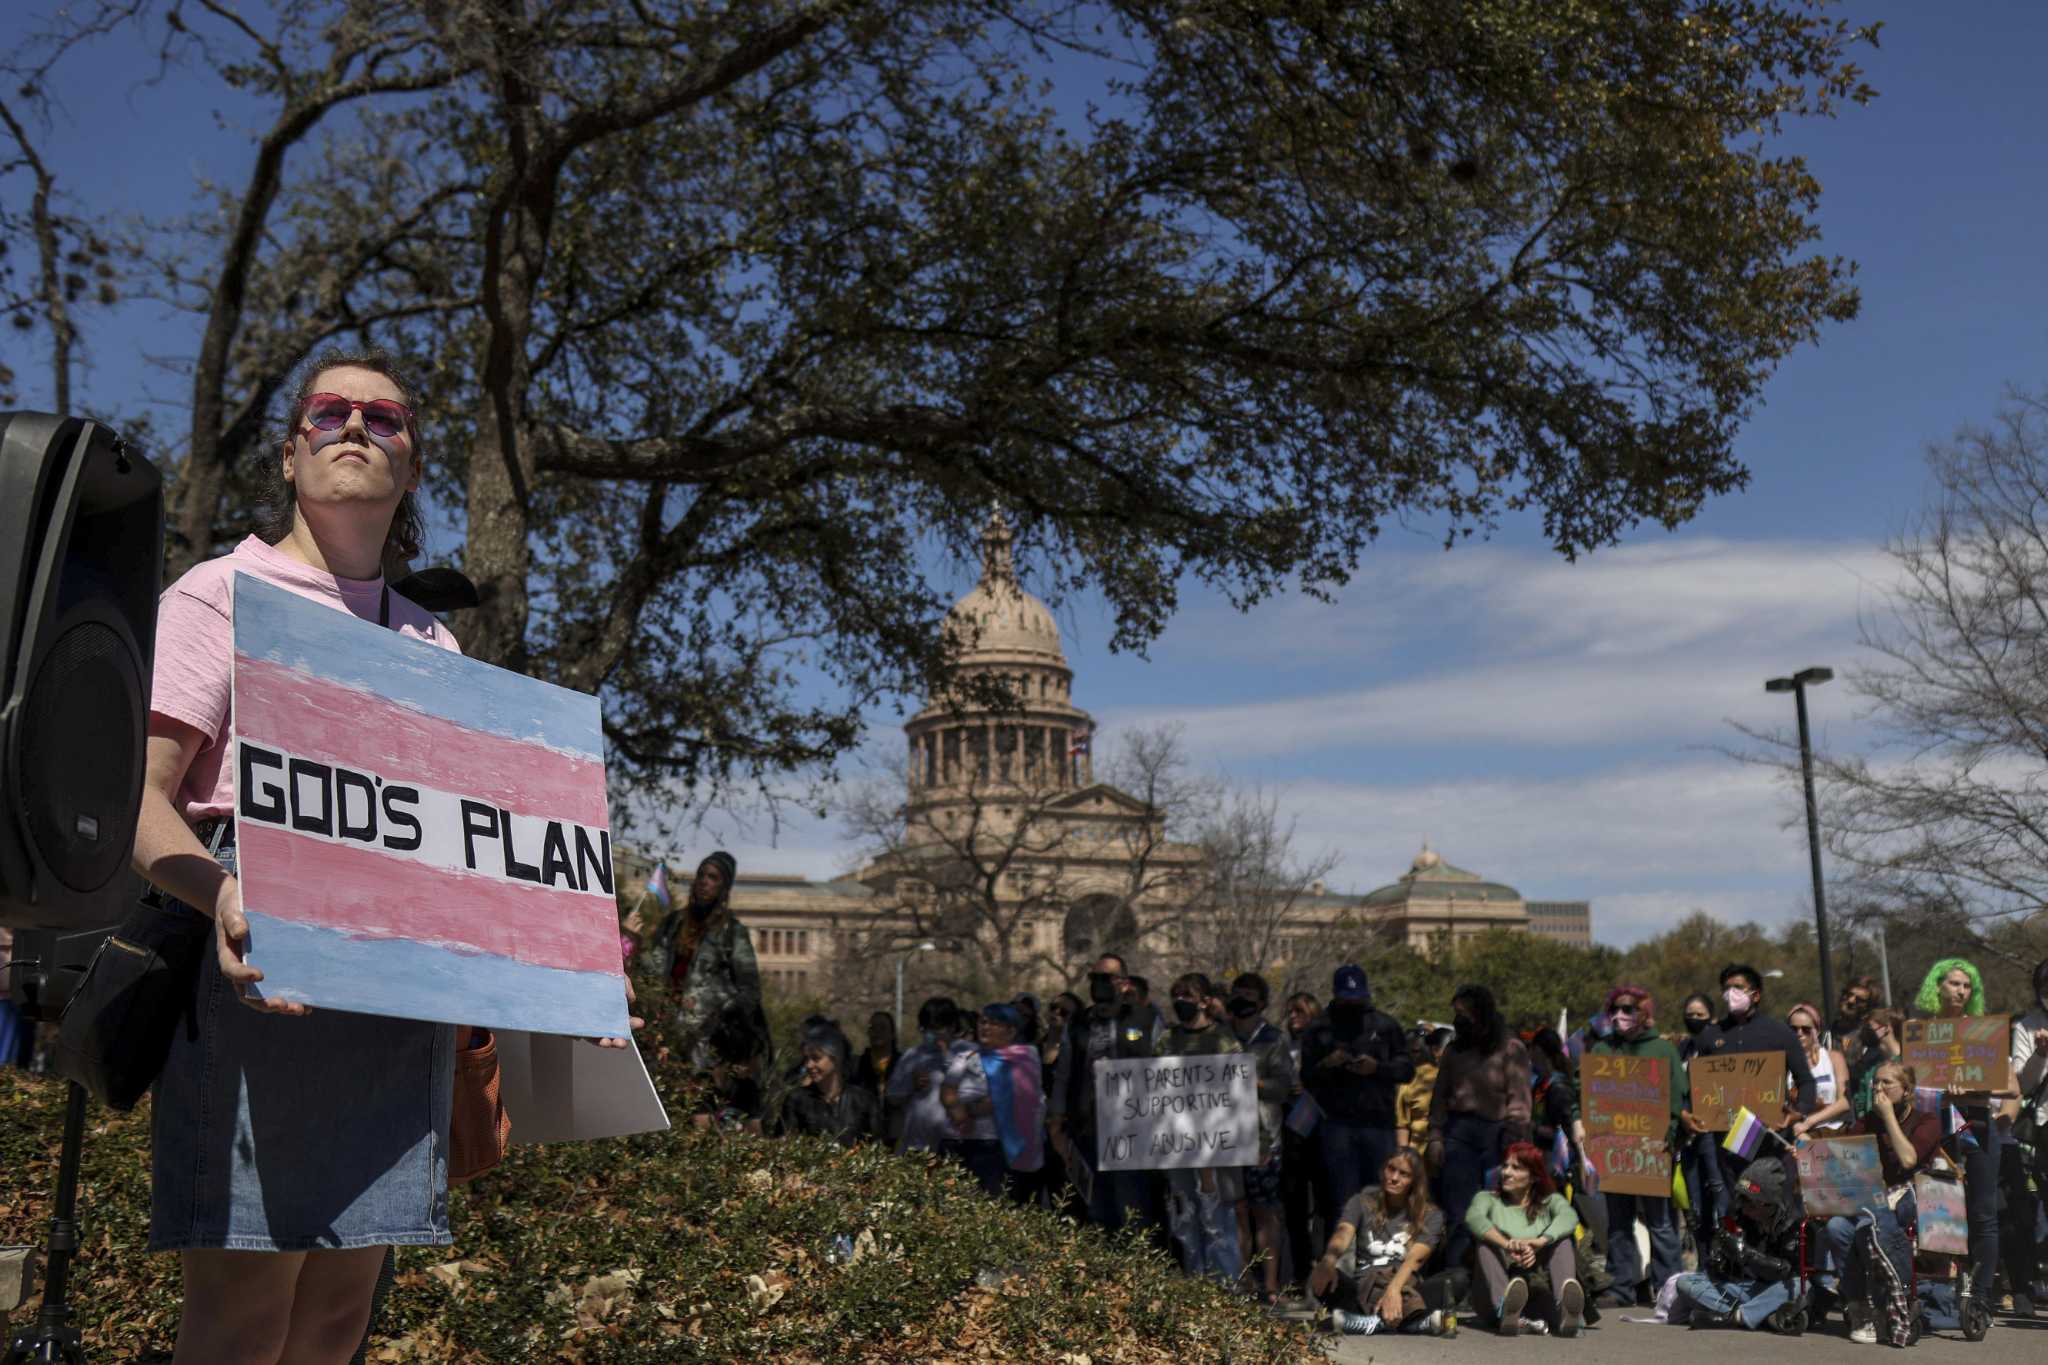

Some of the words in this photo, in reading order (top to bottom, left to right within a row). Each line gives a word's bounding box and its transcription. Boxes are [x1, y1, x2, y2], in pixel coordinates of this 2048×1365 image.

[240, 742, 422, 851] GOD'S
[460, 799, 614, 894] PLAN
[1105, 1070, 1132, 1096] MY
[1144, 1065, 1215, 1090] PARENTS
[1222, 1063, 1250, 1082] ARE
[1123, 1092, 1233, 1121] SUPPORTIVE
[1103, 1134, 1138, 1161] NOT
[1150, 1130, 1237, 1157] ABUSIVE
